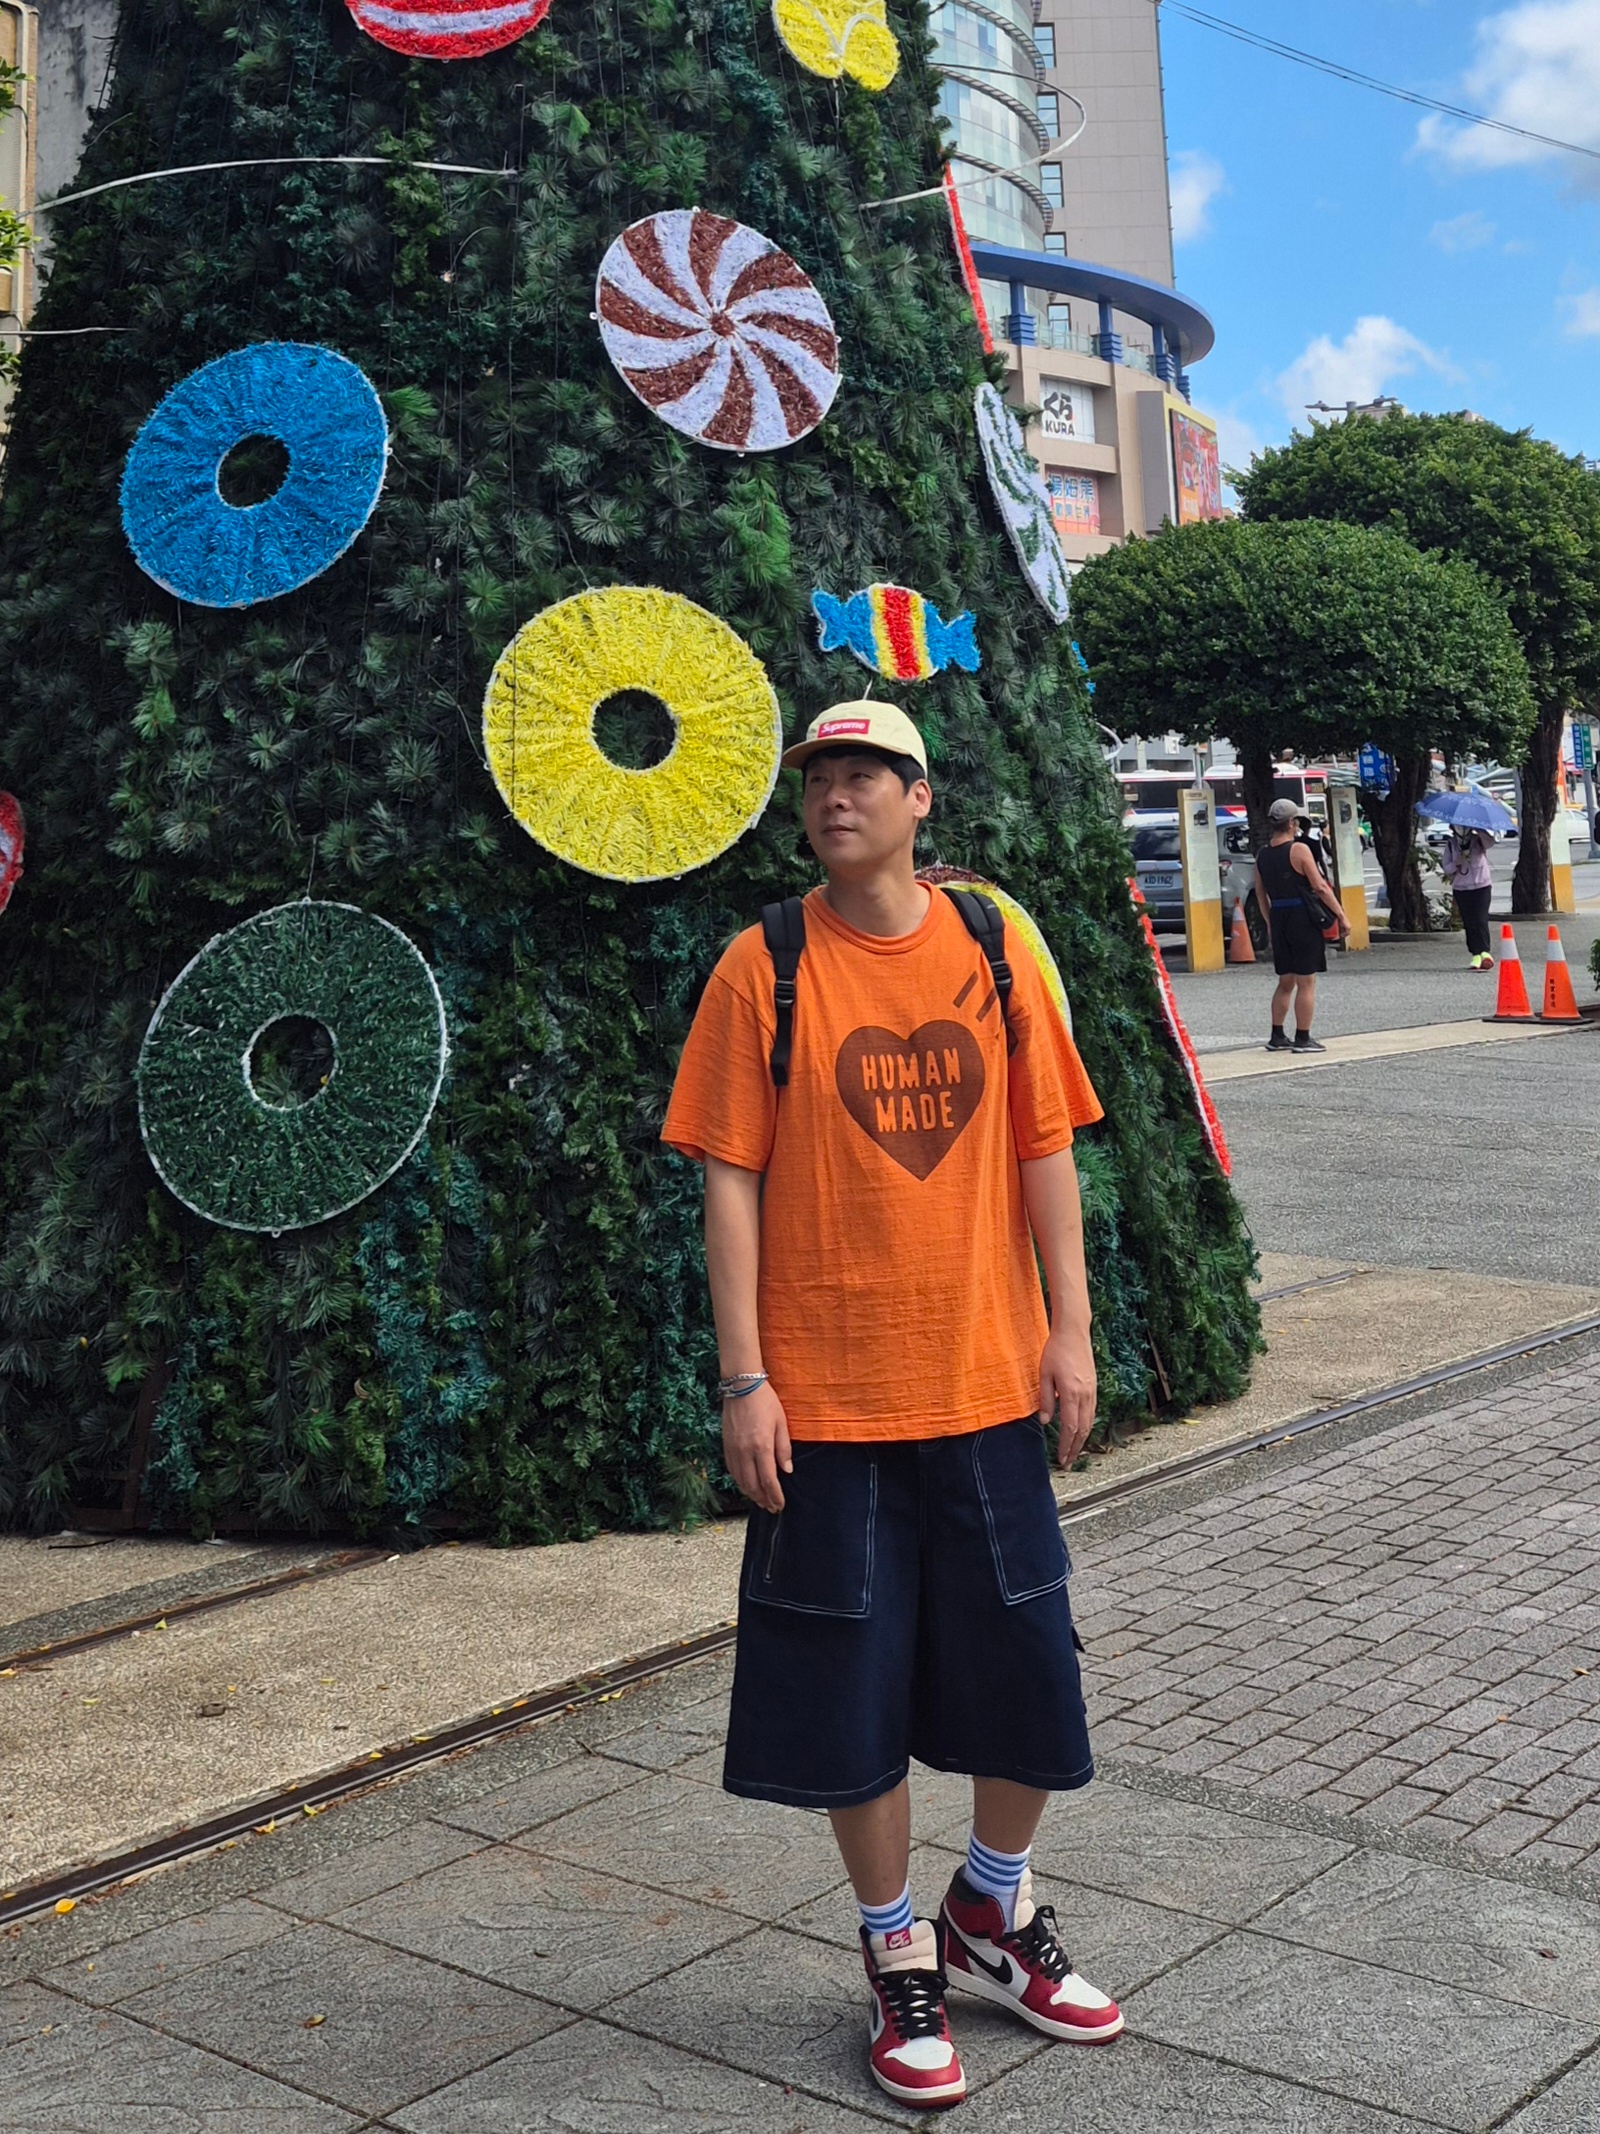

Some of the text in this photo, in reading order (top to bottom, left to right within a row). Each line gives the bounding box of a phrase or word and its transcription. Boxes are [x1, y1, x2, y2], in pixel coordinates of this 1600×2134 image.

[1044, 391, 1073, 421] くら
[1045, 419, 1075, 436] KURA
[821, 721, 866, 734] Supreme
[861, 1046, 962, 1091] HUMAN
[875, 1091, 955, 1133] MADE
